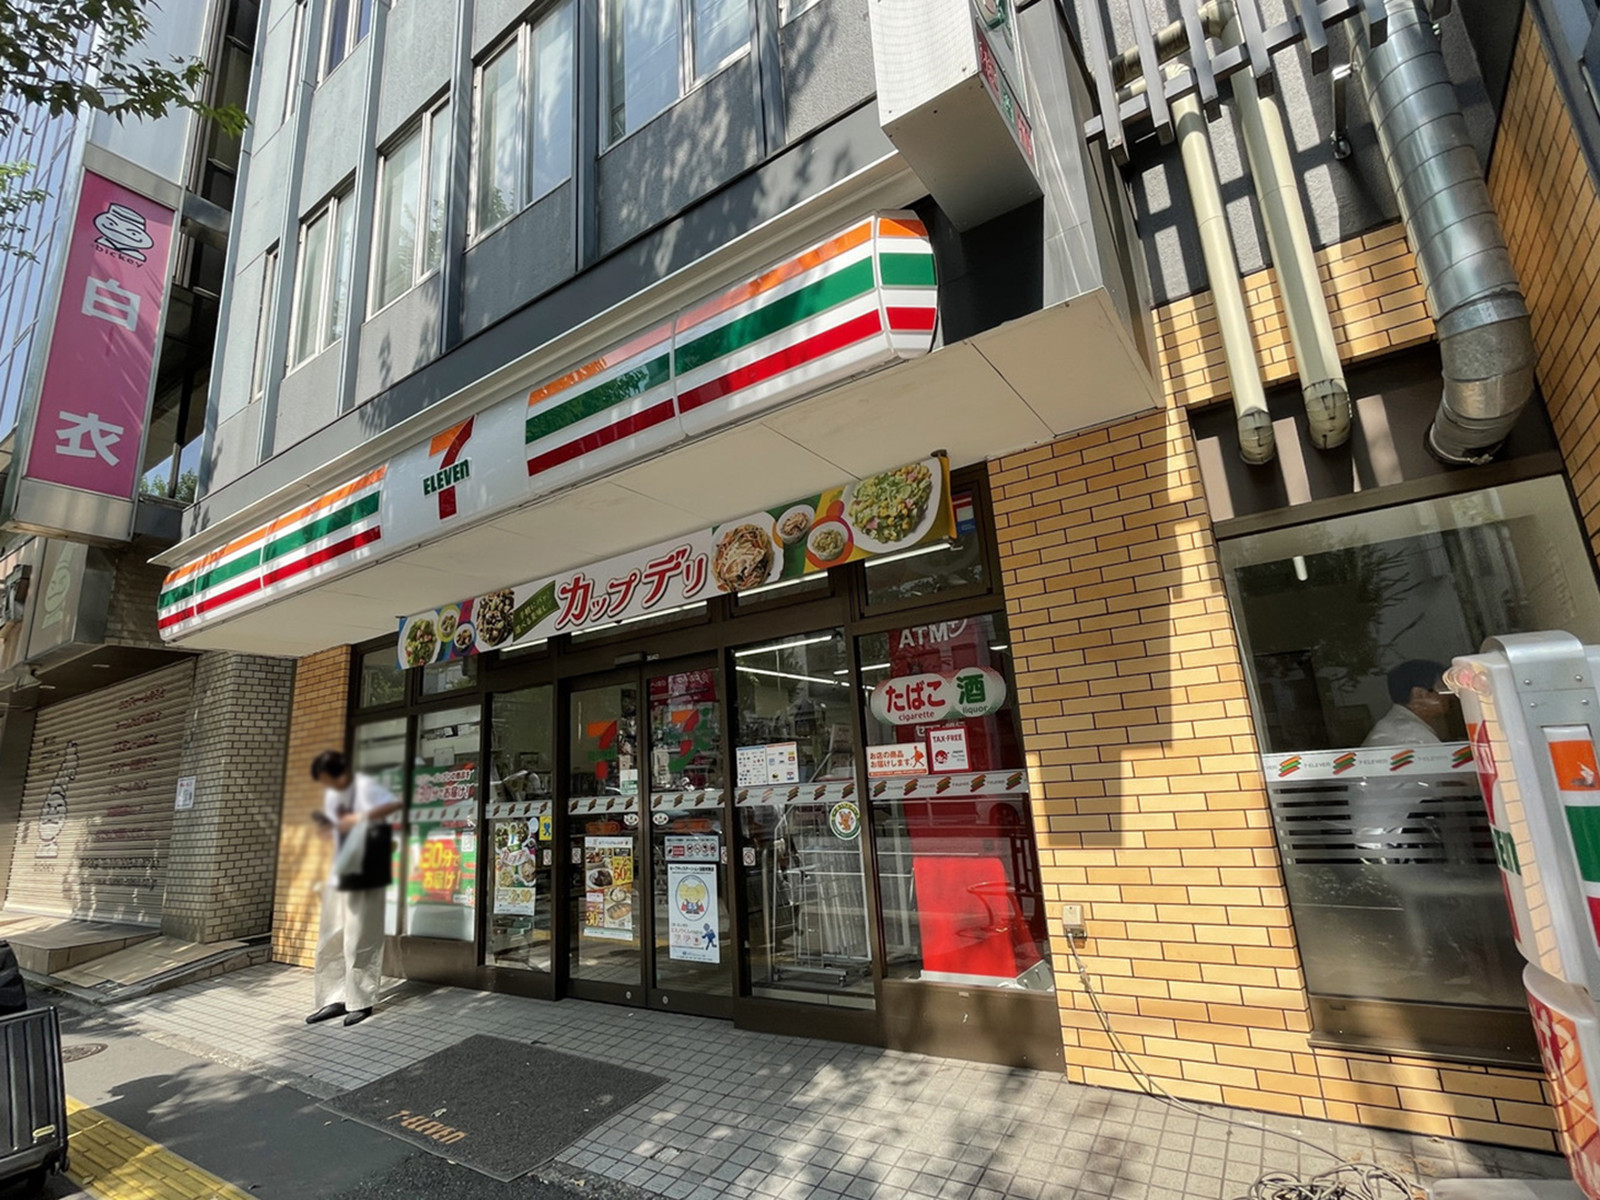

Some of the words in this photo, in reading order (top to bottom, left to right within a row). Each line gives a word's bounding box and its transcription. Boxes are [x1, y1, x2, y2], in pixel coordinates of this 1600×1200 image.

[95, 244, 143, 268] bickey
[56, 277, 141, 467] 白衣
[428, 414, 476, 520] 7
[556, 546, 707, 629] カップデリ
[899, 621, 949, 649] ATM
[885, 680, 946, 713] たばこ
[956, 673, 986, 705] 酒
[898, 710, 935, 723] cigarette
[962, 703, 990, 715] liquor
